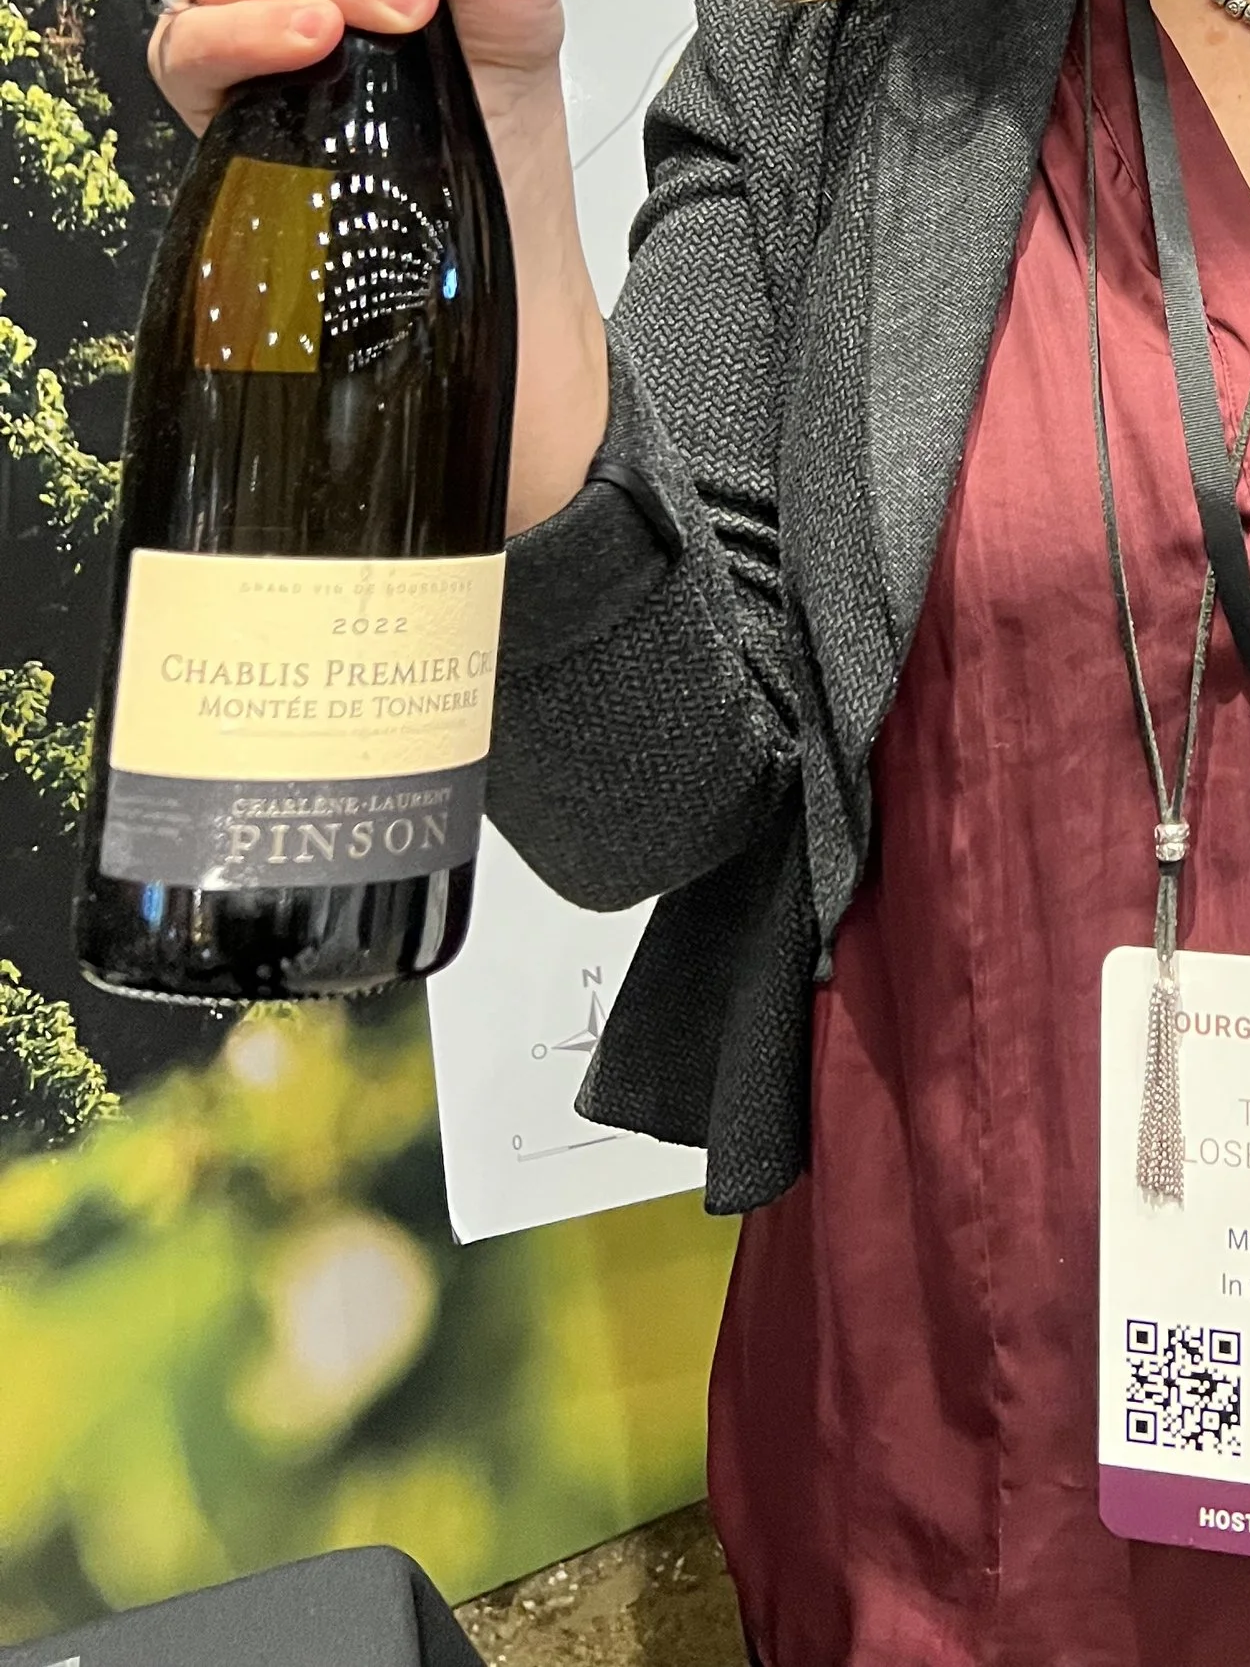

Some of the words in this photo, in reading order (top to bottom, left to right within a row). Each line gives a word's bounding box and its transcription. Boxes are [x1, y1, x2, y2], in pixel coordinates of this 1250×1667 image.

[332, 616, 409, 635] 2022
[161, 653, 310, 687] CHABLIS
[323, 656, 461, 687] PREMIER
[198, 695, 318, 719] MONTÉE
[327, 699, 364, 719] DE
[372, 688, 479, 718] TONNERRE
[225, 812, 448, 865] PINSON
[581, 965, 603, 988] N
[1221, 1272, 1242, 1297] In
